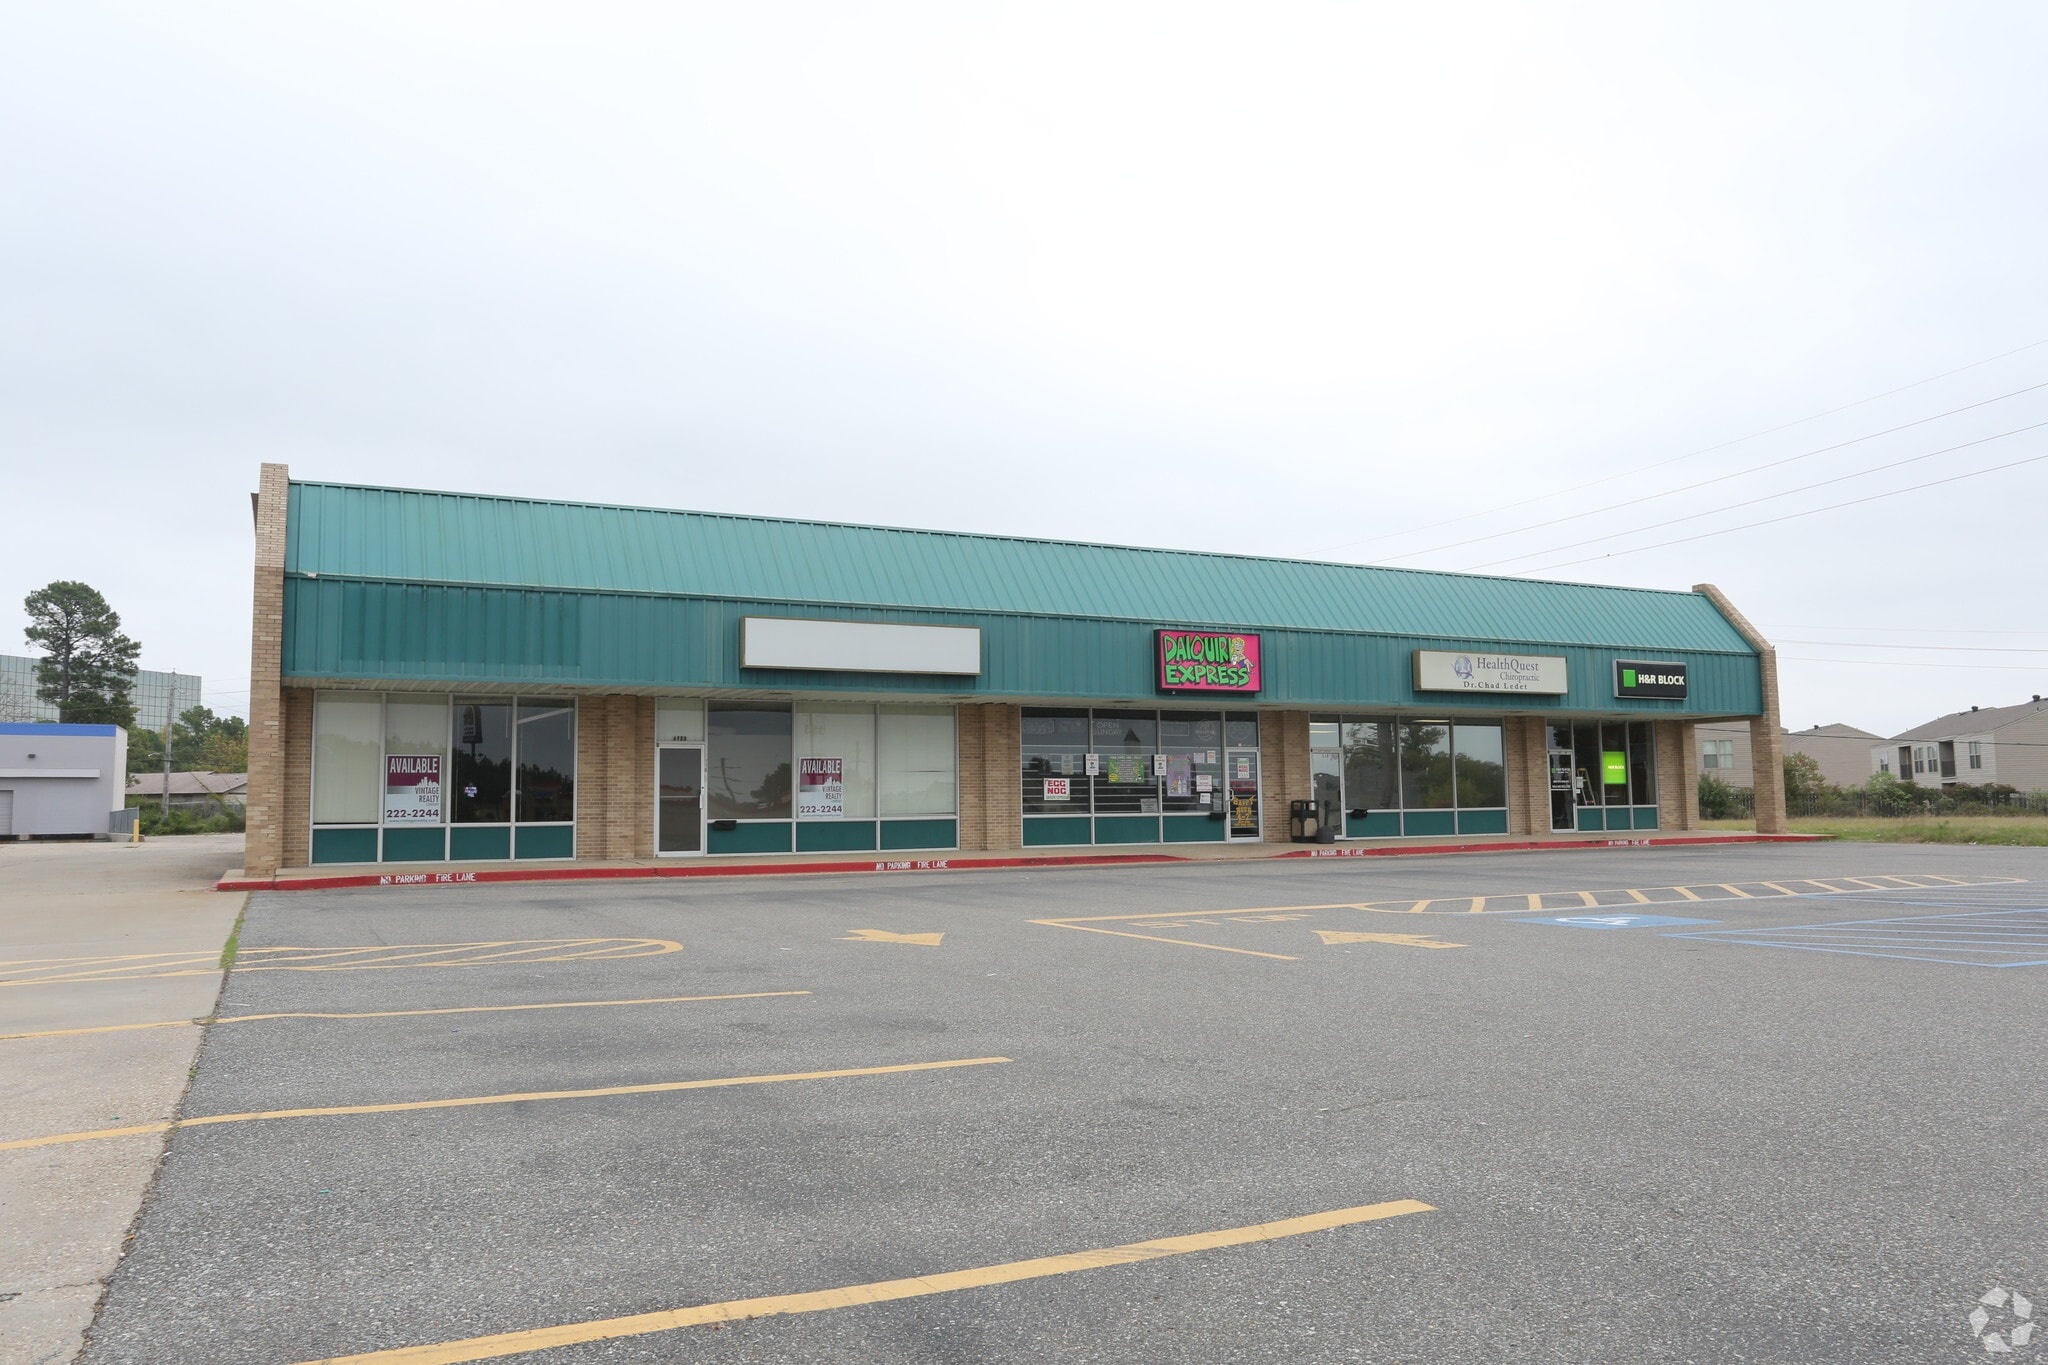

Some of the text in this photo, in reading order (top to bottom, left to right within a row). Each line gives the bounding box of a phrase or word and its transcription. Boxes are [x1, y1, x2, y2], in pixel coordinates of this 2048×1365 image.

[1163, 634, 1232, 663] DAIQUIRI
[1477, 657, 1539, 674] HealthQuest
[1165, 664, 1250, 686] EXPRESS
[1500, 671, 1540, 683] Chiropractic
[1638, 674, 1685, 685] H&R BLOCK
[390, 758, 438, 773] AVAILABLE
[802, 760, 841, 774] AVAILABLE
[415, 787, 440, 795] VINTAGE
[386, 809, 439, 818] 222-2244
[800, 805, 842, 813] 222-2244
[876, 860, 948, 871] NO PARKING FIRE LANE
[380, 872, 476, 884] NO PARKING FIRE LANE
